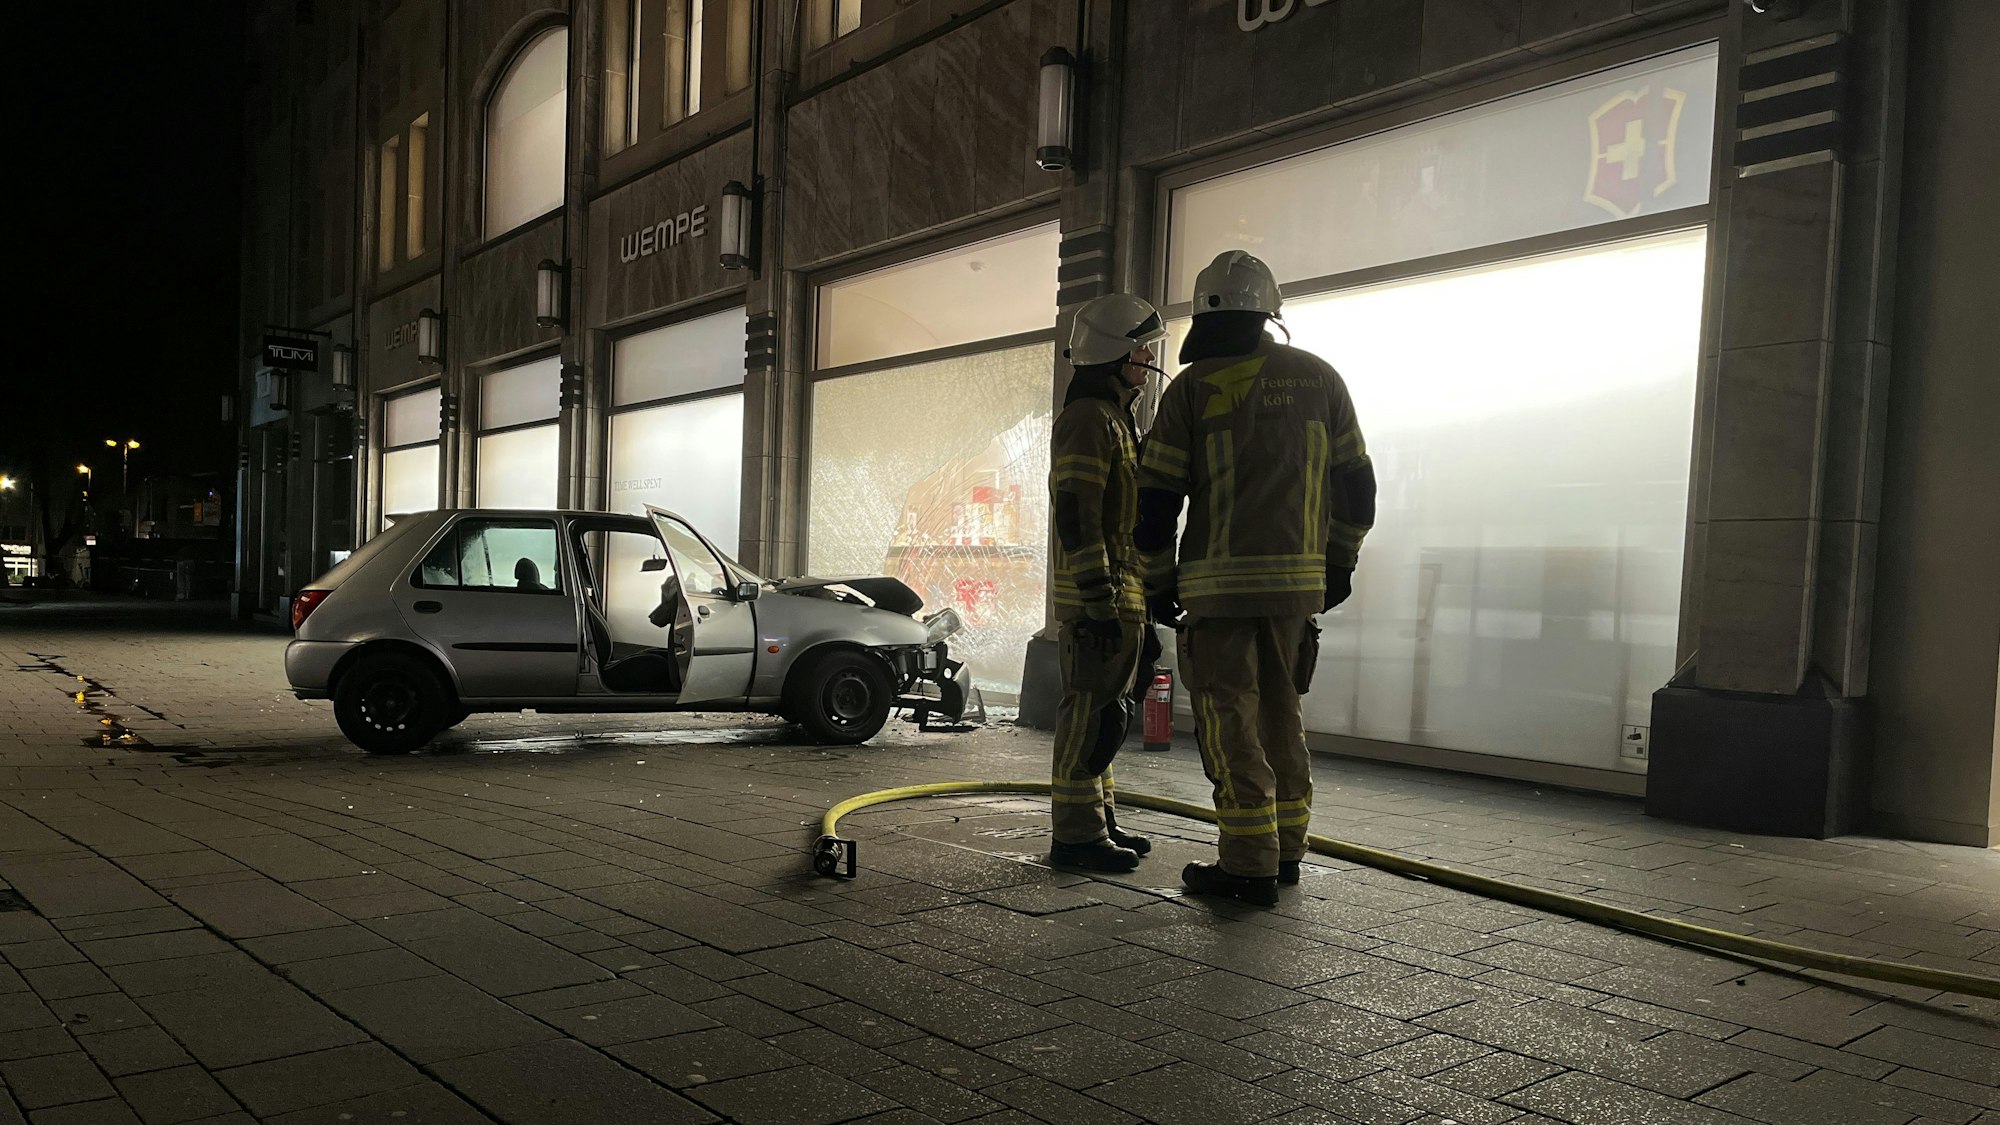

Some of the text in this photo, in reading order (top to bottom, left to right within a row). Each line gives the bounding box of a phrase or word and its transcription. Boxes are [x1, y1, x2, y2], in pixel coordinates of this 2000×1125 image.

[620, 204, 707, 263] WEMPE
[384, 320, 419, 350] WEMP
[268, 345, 314, 362] TUMI
[1260, 375, 1323, 390] Feuerwe
[1263, 391, 1295, 407] Köln
[643, 477, 663, 490] SPENT
